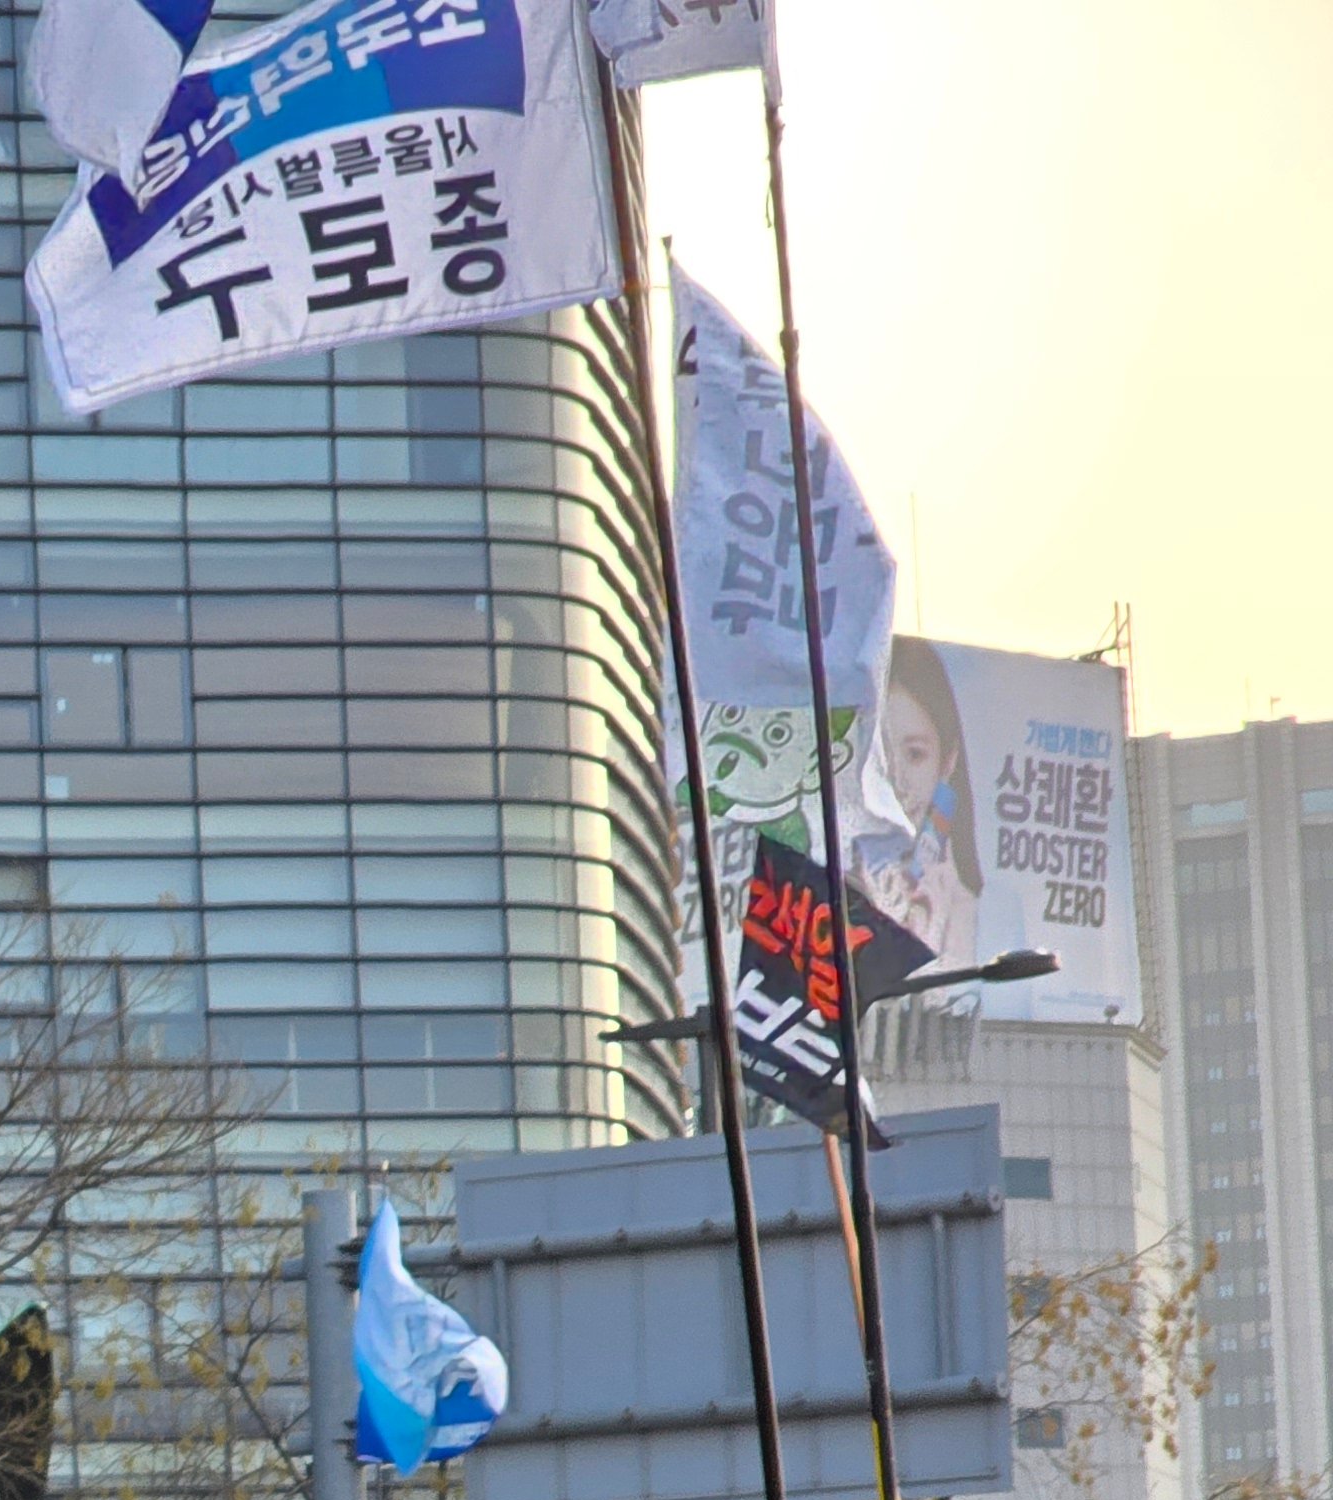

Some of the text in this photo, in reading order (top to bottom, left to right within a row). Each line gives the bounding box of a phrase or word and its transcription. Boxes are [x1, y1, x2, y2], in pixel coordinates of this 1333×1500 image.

[995, 754, 1113, 833] 상쾌환
[997, 826, 1108, 882] BOOSTER
[1043, 880, 1106, 928] ZERO
